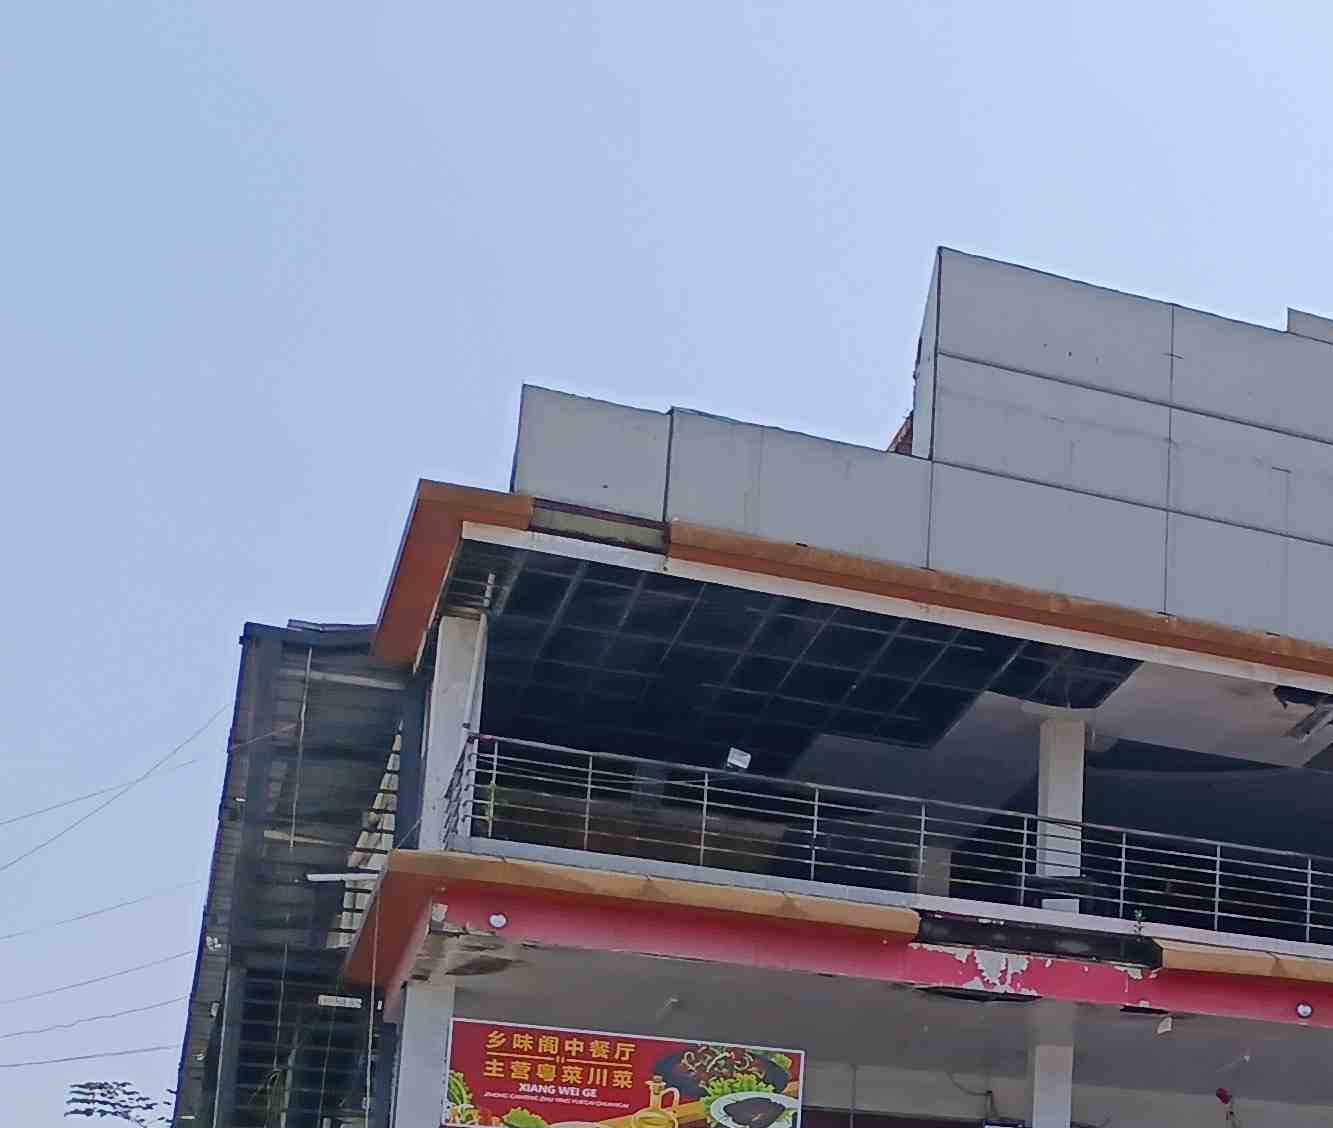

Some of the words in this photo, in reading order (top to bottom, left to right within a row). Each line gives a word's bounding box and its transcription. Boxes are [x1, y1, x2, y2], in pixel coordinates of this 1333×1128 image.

[485, 1030, 636, 1061] 乡味阁中餐厅
[518, 1082, 556, 1094] XIANG
[558, 1086, 580, 1097] WEI
[582, 1088, 598, 1098] GE
